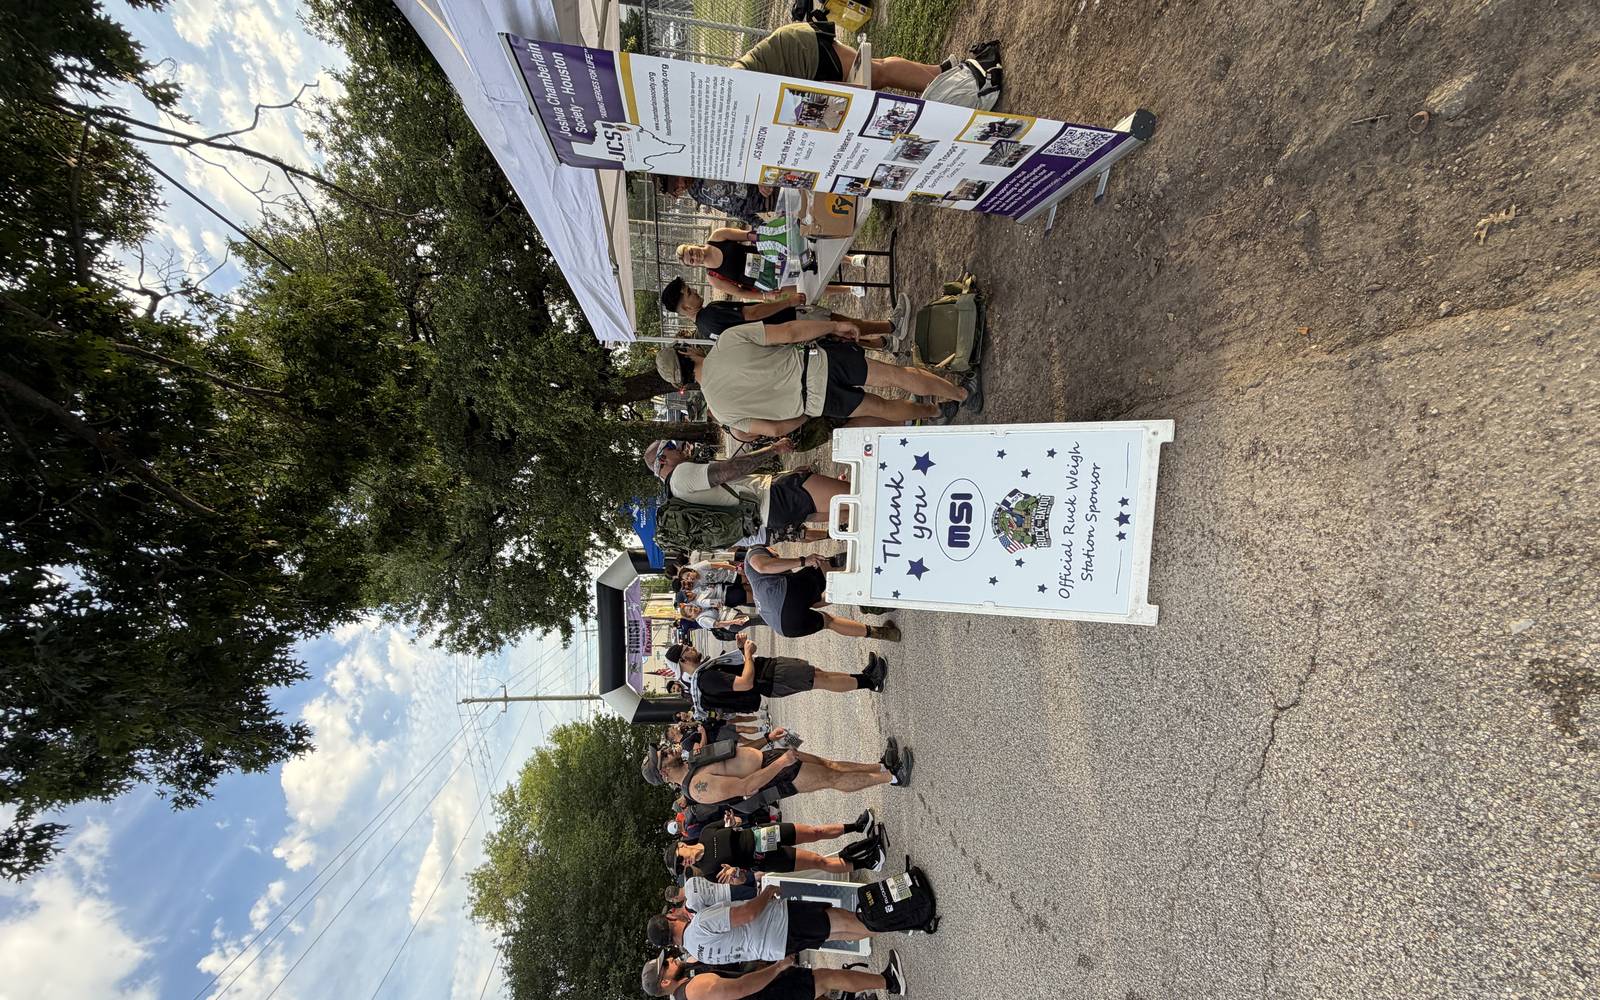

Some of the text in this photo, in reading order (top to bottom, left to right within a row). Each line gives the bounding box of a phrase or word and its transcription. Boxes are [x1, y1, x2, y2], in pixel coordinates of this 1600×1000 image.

[528, 42, 572, 136] Joshua Chamberlain
[552, 52, 576, 94] Houston
[588, 68, 598, 81] FOR
[570, 104, 588, 133] Society
[604, 131, 626, 161] JCS
[753, 126, 768, 160] JCS HOUSTON
[777, 153, 788, 166] "Ruck
[783, 128, 796, 145] Bayou"
[824, 159, 838, 178] "Hooked
[835, 129, 854, 152] Veterans"
[937, 143, 958, 161] Troops"
[882, 471, 905, 563] Thank
[912, 485, 932, 539] you
[948, 493, 973, 548] MSI
[1035, 495, 1050, 520] BAYOU
[1058, 442, 1083, 598] Official Ruck Weigh
[1081, 462, 1101, 582] Station Sponsor
[1035, 527, 1048, 547] RUCK
[628, 620, 640, 654] FINISH
